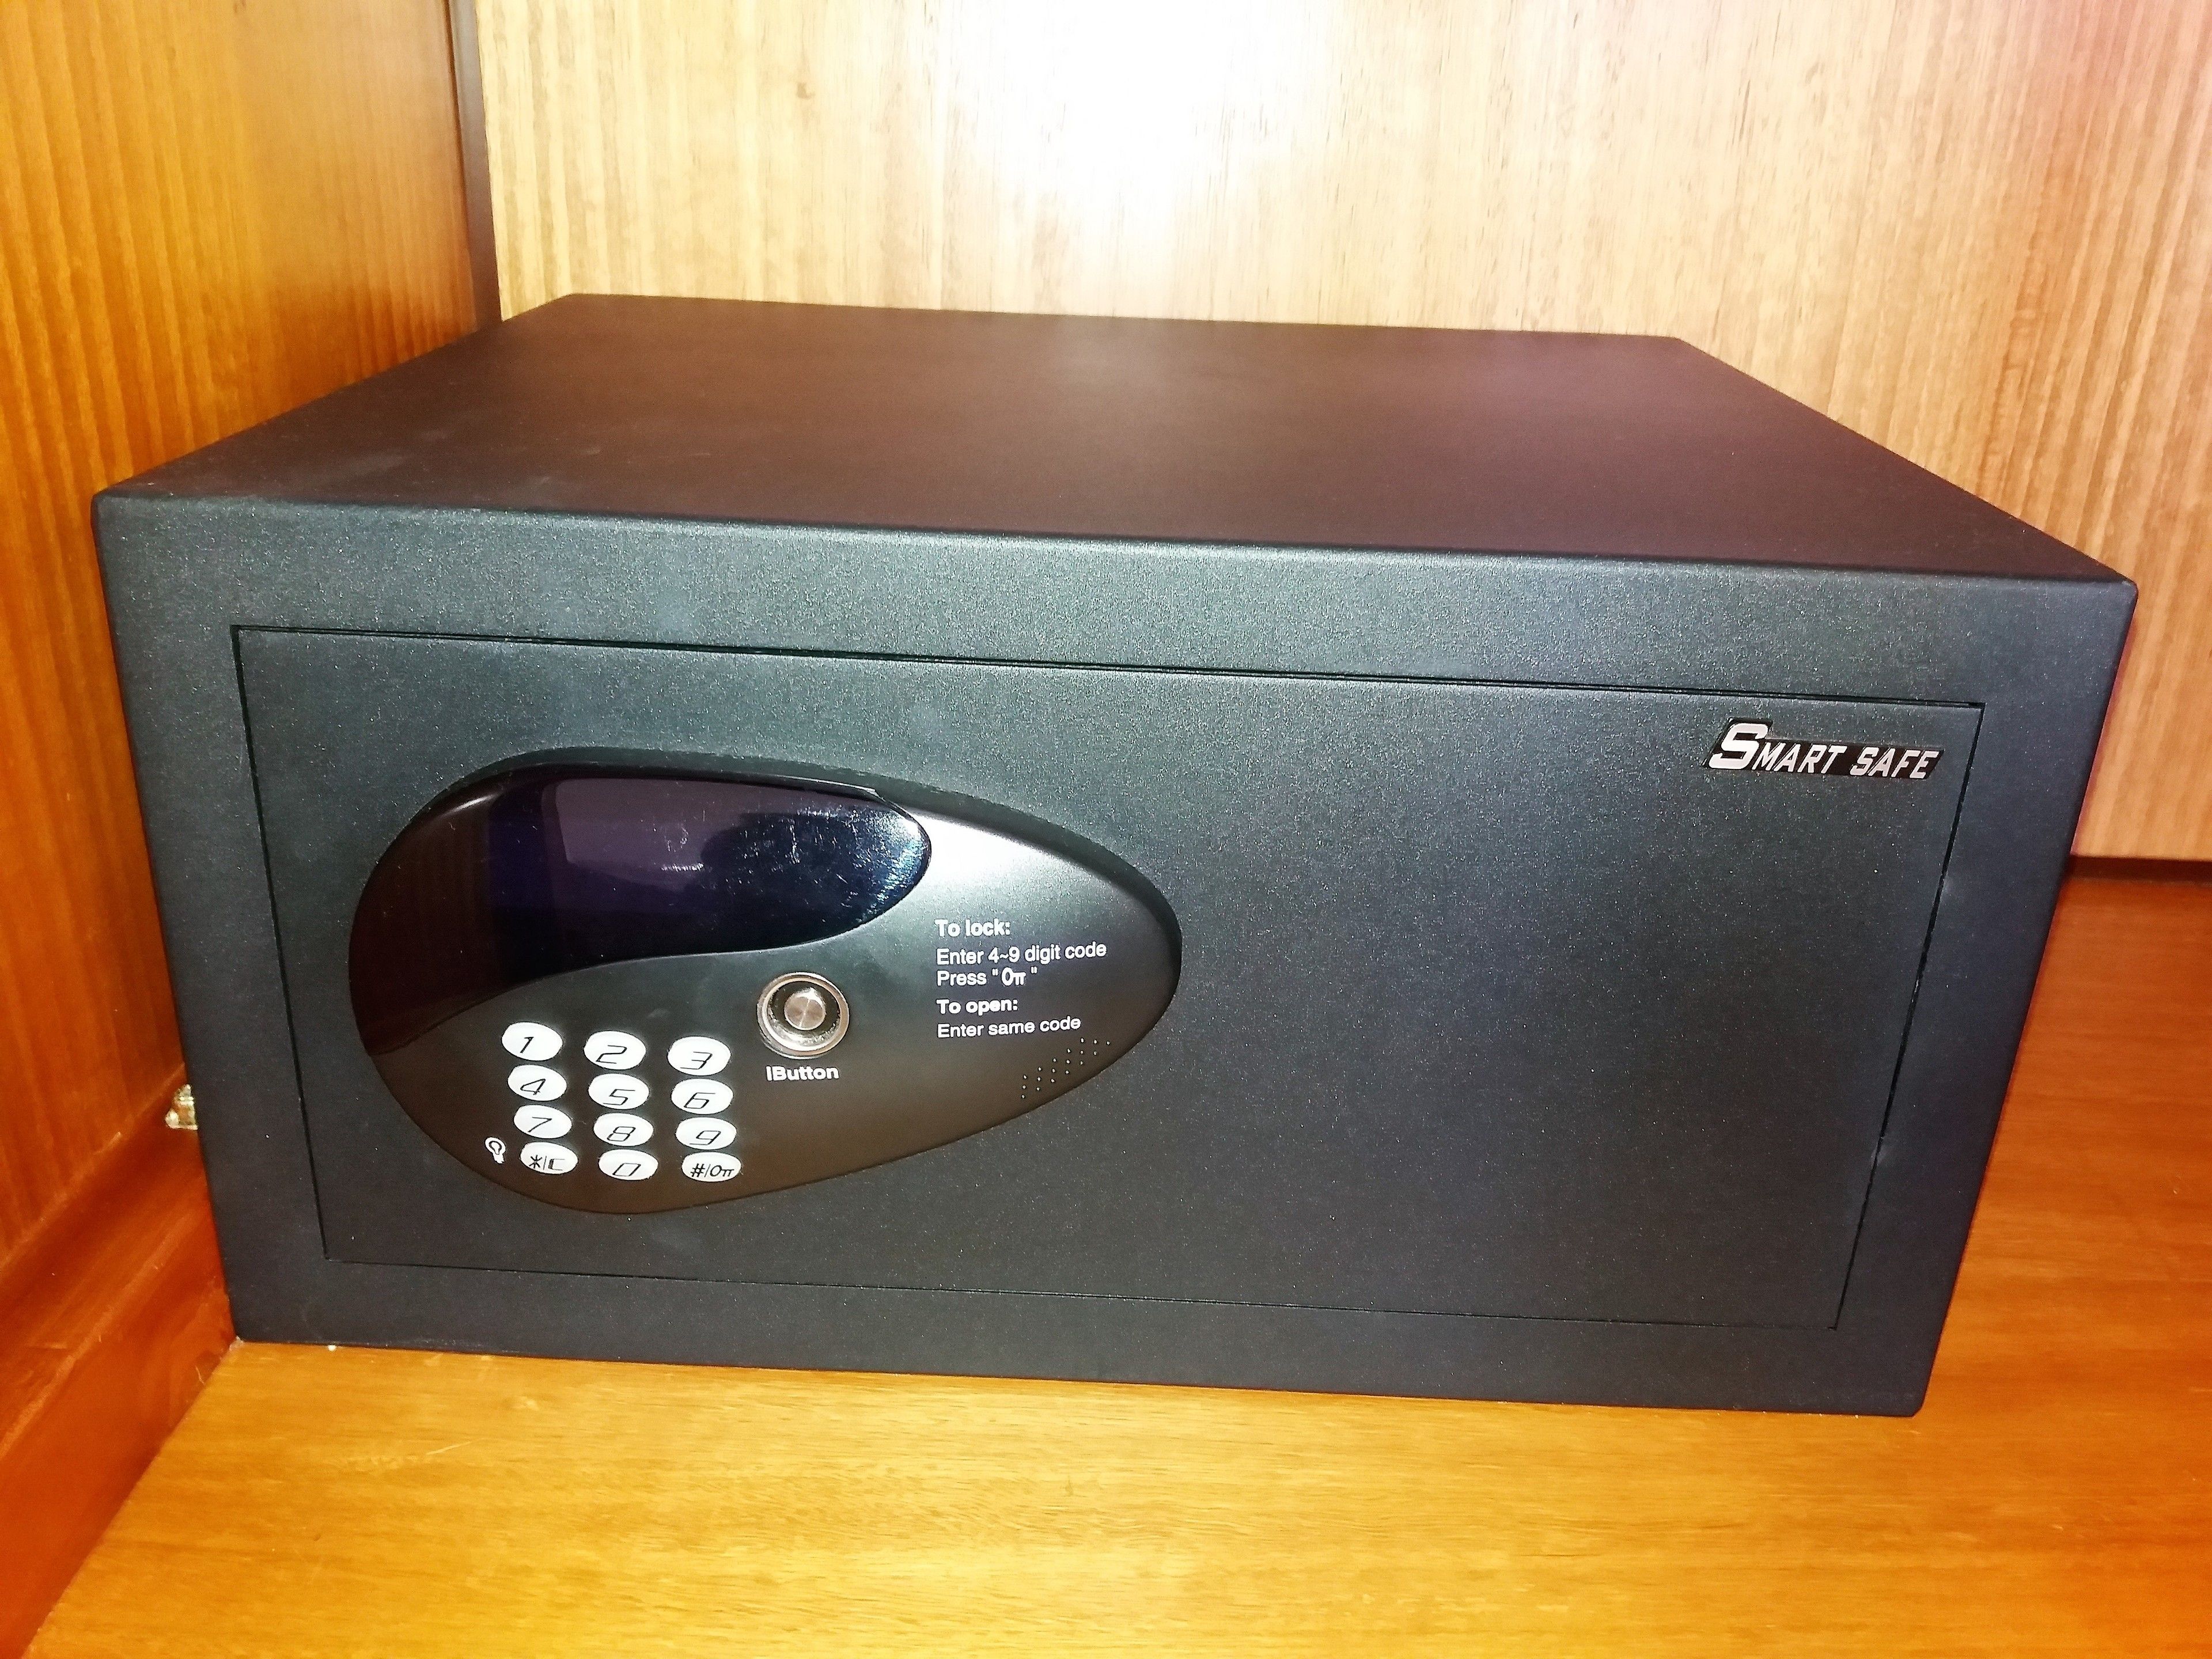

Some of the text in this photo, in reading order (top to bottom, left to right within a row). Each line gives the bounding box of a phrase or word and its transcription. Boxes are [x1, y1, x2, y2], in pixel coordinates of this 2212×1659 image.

[1709, 722, 1939, 779] SMART SAFE
[934, 918, 1010, 937] To lock:
[936, 948, 984, 965] Enter
[1024, 944, 1061, 964] digit
[1065, 941, 1107, 959] code
[936, 970, 987, 986] Press
[936, 999, 1018, 1016] To open:
[937, 1016, 1081, 1038] Enter same code
[520, 1036, 534, 1054] 1
[595, 1044, 627, 1064] 2
[680, 1051, 713, 1070] 3
[520, 1078, 546, 1095] 4
[603, 1089, 635, 1105] 5
[683, 1092, 716, 1109] 6
[527, 1116, 552, 1132] 7
[607, 1126, 636, 1142] 8
[689, 1130, 721, 1146] 9
[612, 1162, 641, 1177] 0
